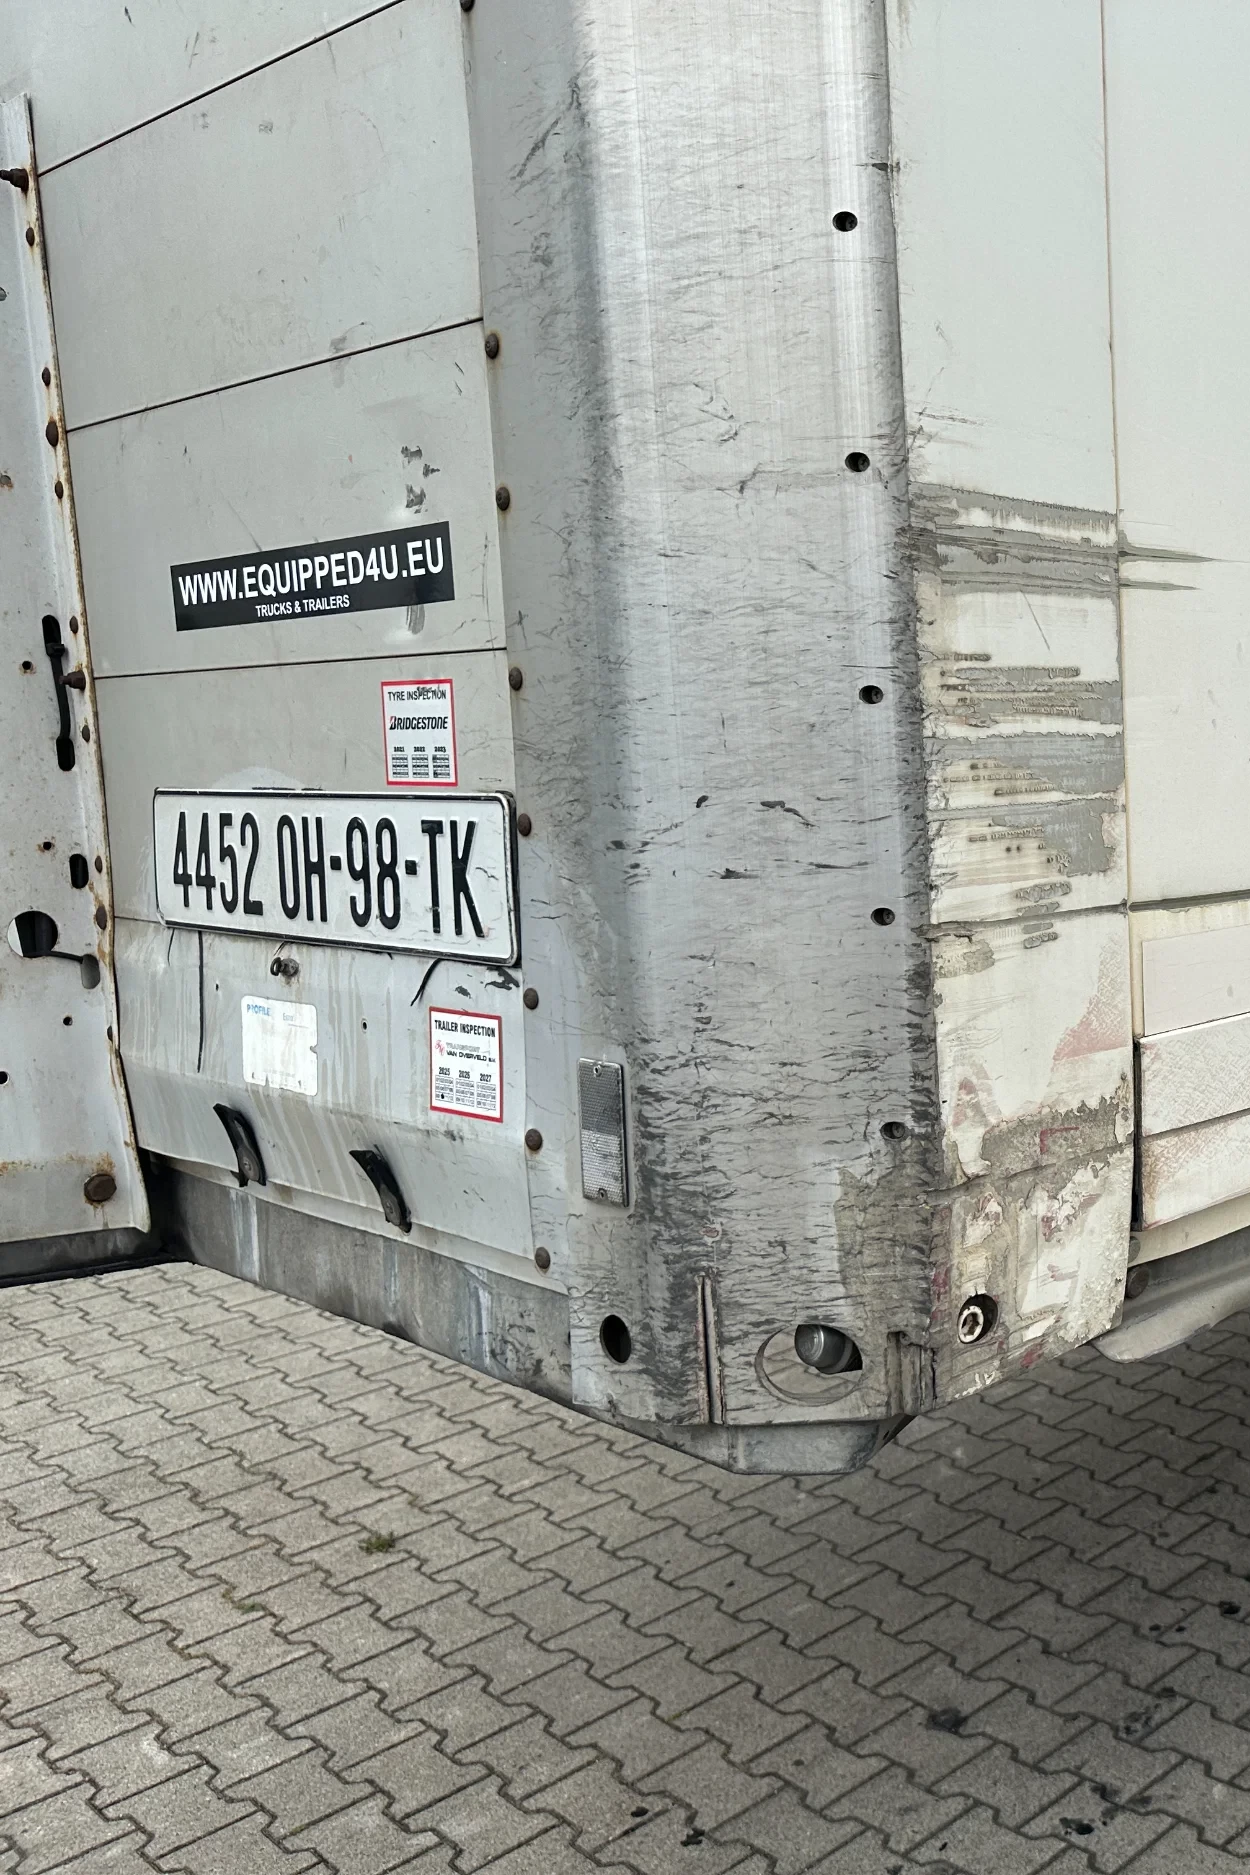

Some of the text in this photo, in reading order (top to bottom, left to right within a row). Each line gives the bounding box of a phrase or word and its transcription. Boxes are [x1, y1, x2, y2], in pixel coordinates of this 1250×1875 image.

[178, 537, 445, 606] WWW.EQUIPPED4U.EU
[255, 594, 350, 617] TRUCKS & TRAILERS
[388, 690, 446, 701] TYRE INSPECTION
[389, 716, 448, 730] BRIDGESTONE
[173, 811, 485, 938] 4452 OH-98-TK
[435, 1020, 496, 1037] TRAILER INSPECTION
[459, 1052, 487, 1061] OVERVELD
[439, 1067, 492, 1082] 2025 2026 2027
